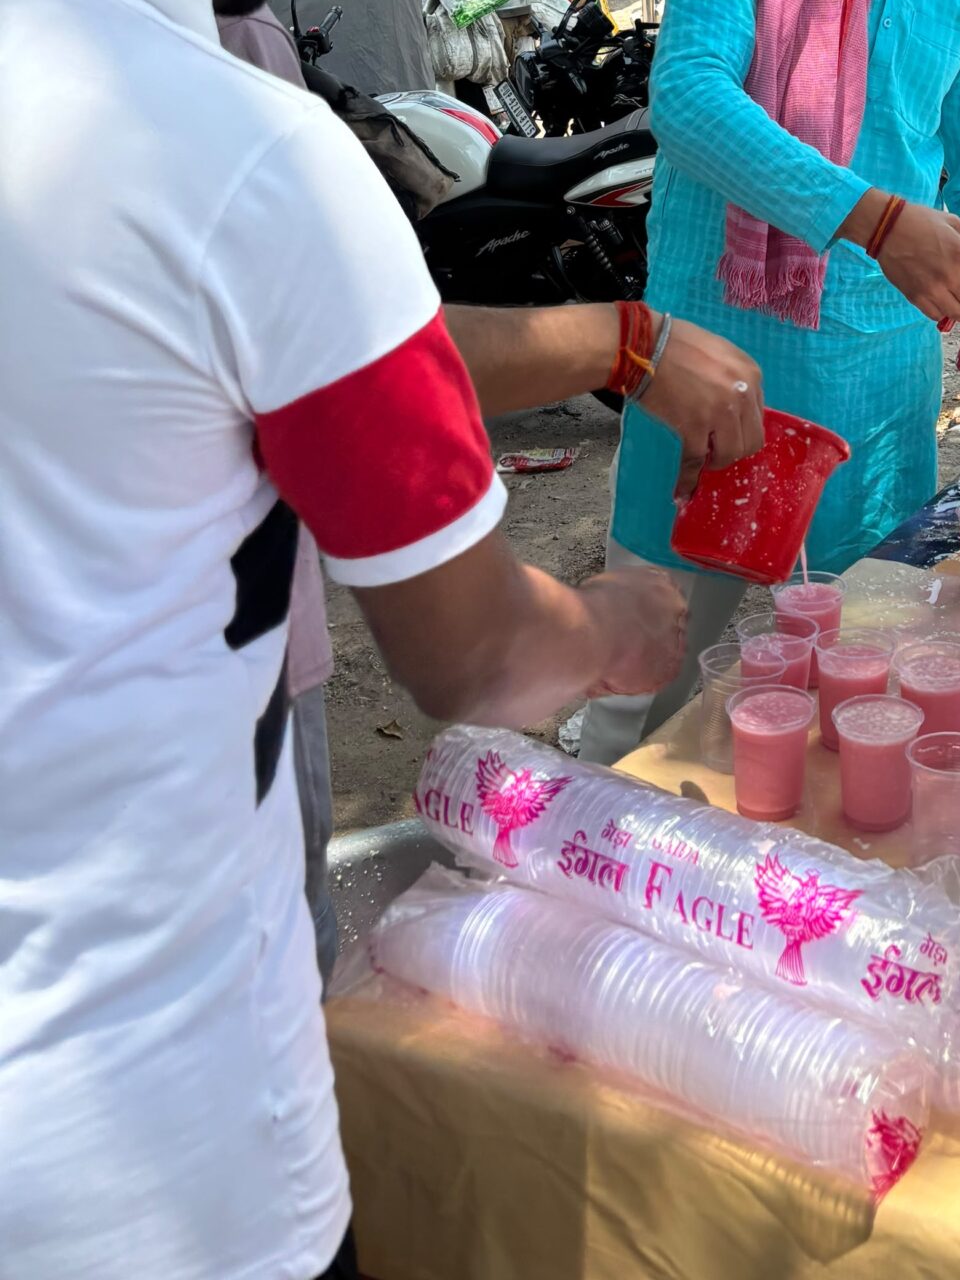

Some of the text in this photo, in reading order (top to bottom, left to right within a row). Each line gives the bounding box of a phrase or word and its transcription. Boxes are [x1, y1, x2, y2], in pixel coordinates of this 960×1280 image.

[594, 142, 630, 160] Apache
[475, 229, 531, 258] Apache
[412, 787, 474, 836] AGLE
[557, 829, 630, 894] ईगल
[860, 943, 942, 1008] ईगल
